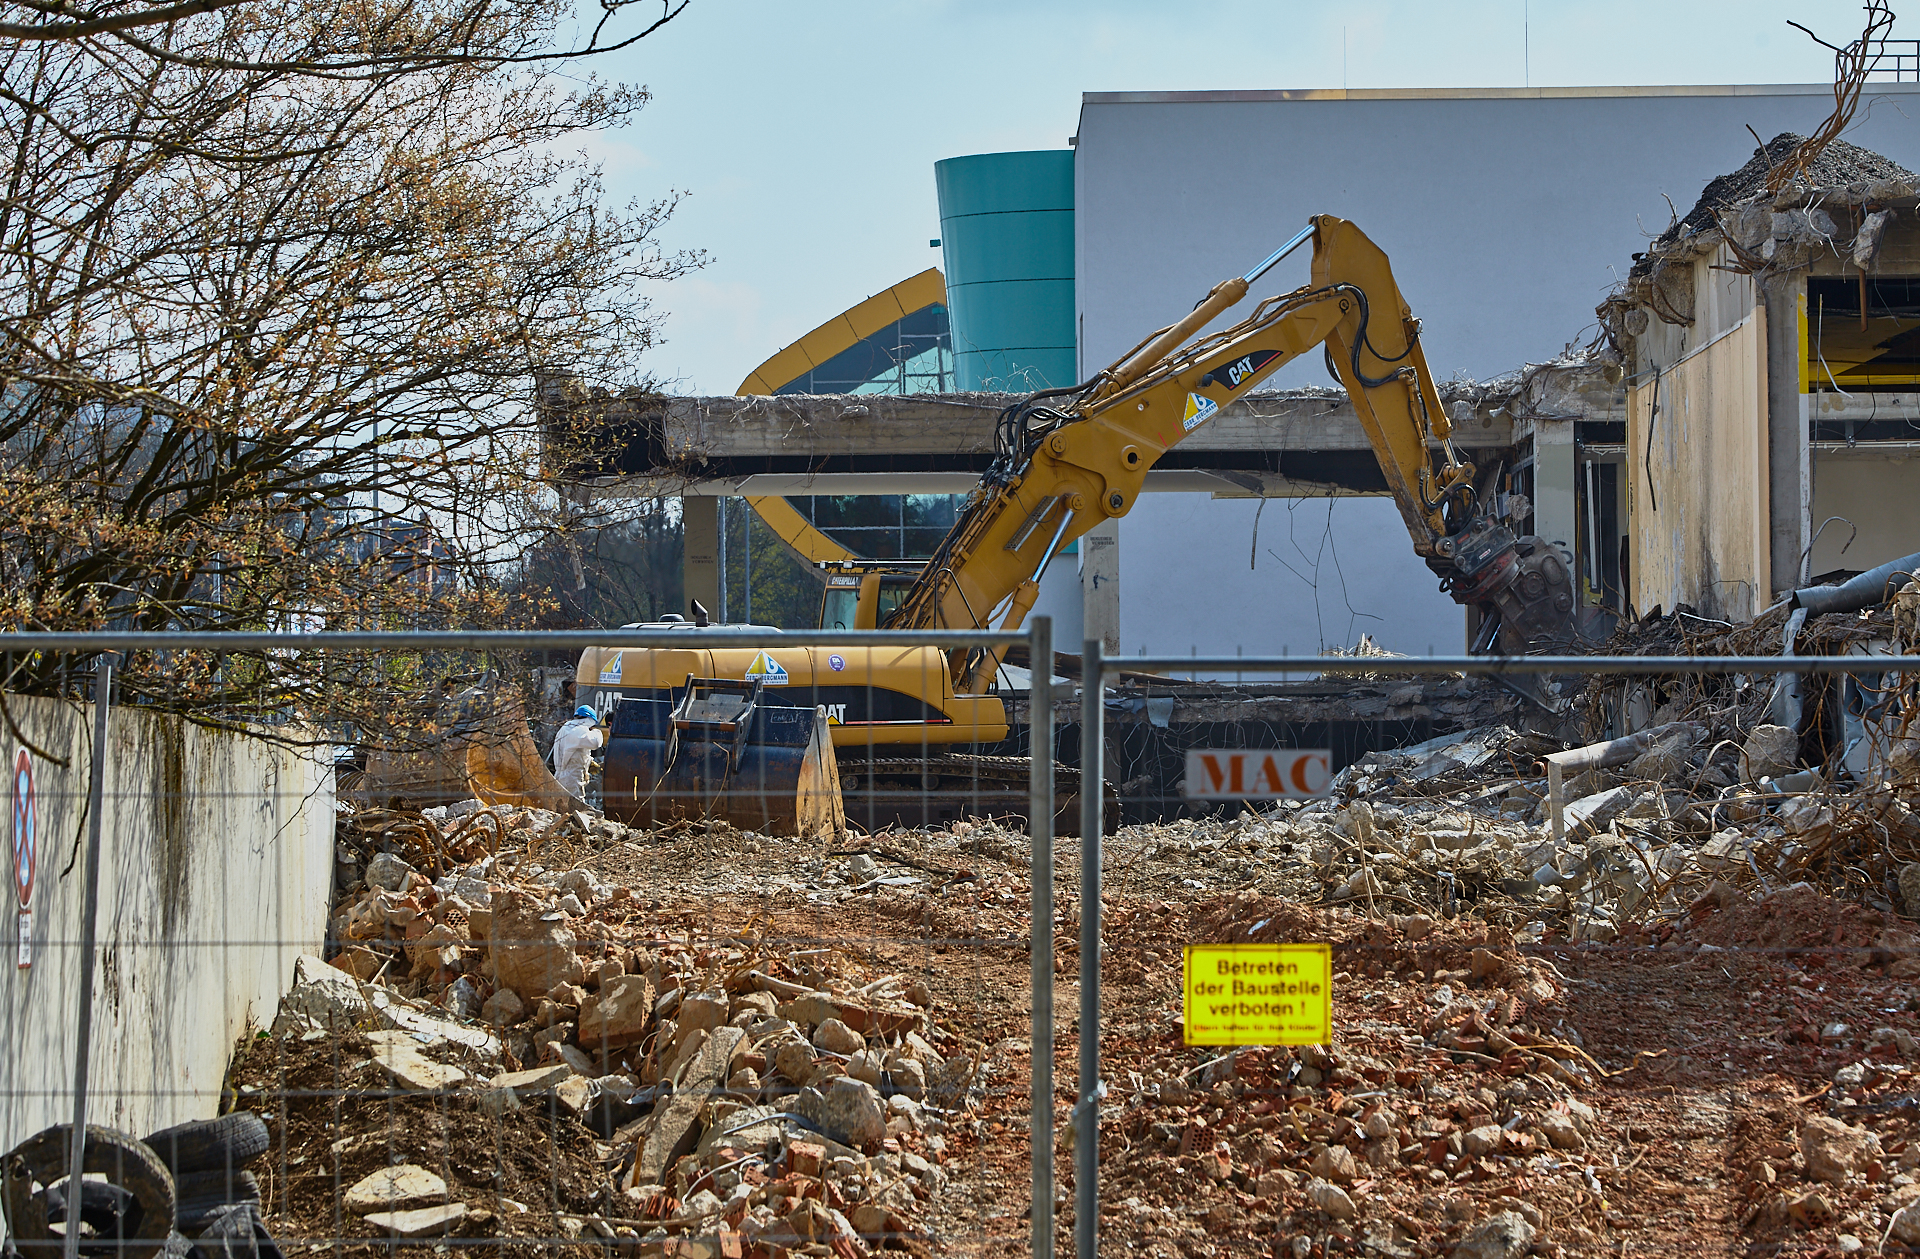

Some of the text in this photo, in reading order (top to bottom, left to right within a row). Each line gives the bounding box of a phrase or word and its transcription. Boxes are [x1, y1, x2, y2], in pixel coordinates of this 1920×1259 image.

[1228, 355, 1255, 385] CAT
[1196, 753, 1330, 795] MAC
[1217, 959, 1298, 976] Betreten
[1194, 980, 1321, 997] der Baustelle
[1209, 1001, 1294, 1017] verboten
